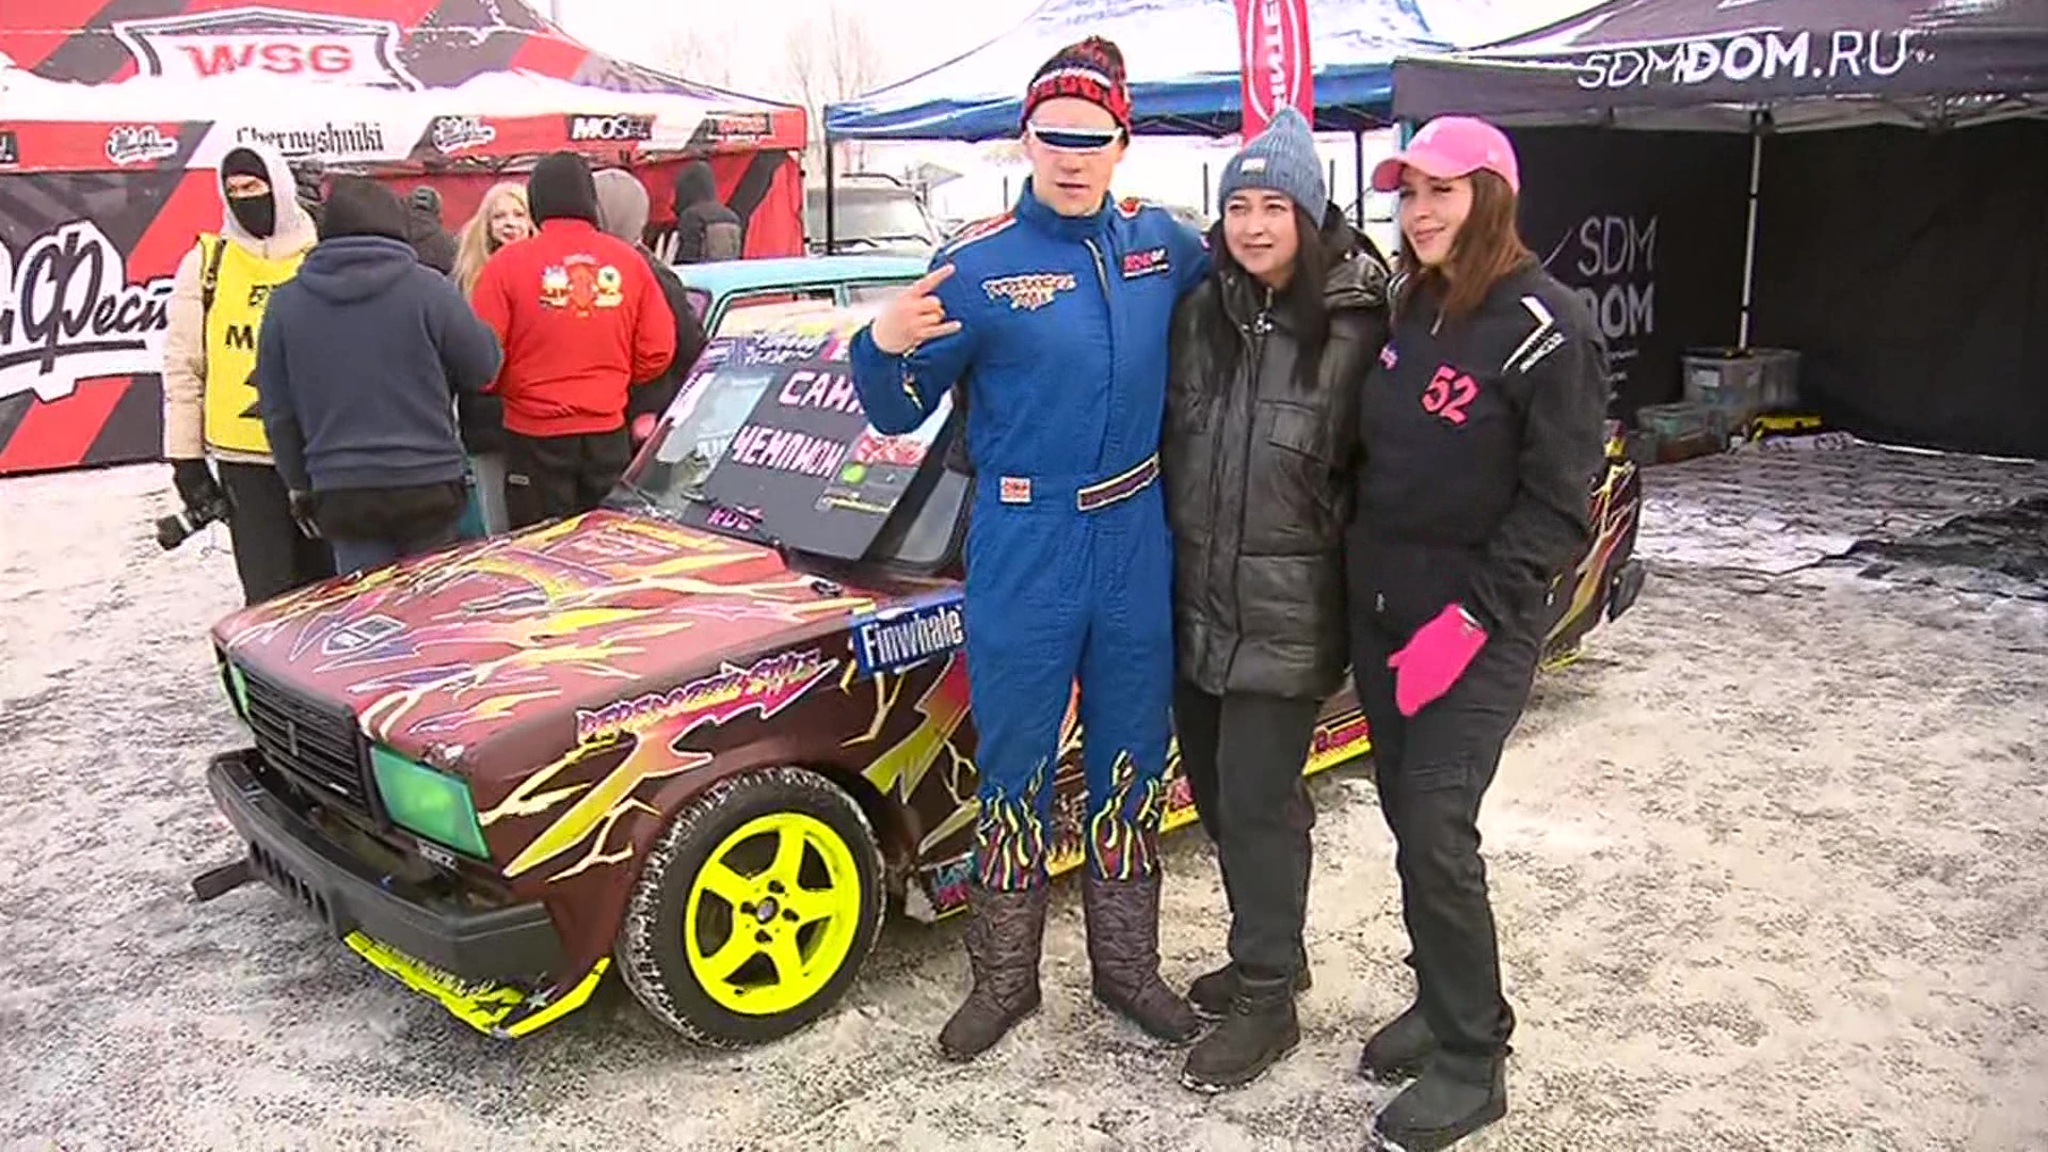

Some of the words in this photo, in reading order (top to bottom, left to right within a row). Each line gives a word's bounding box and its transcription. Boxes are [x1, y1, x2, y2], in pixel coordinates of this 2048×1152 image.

[177, 43, 353, 79] WSG
[1578, 215, 1659, 276] SDM
[1421, 365, 1478, 424] 52
[861, 605, 964, 668] Finwhale
